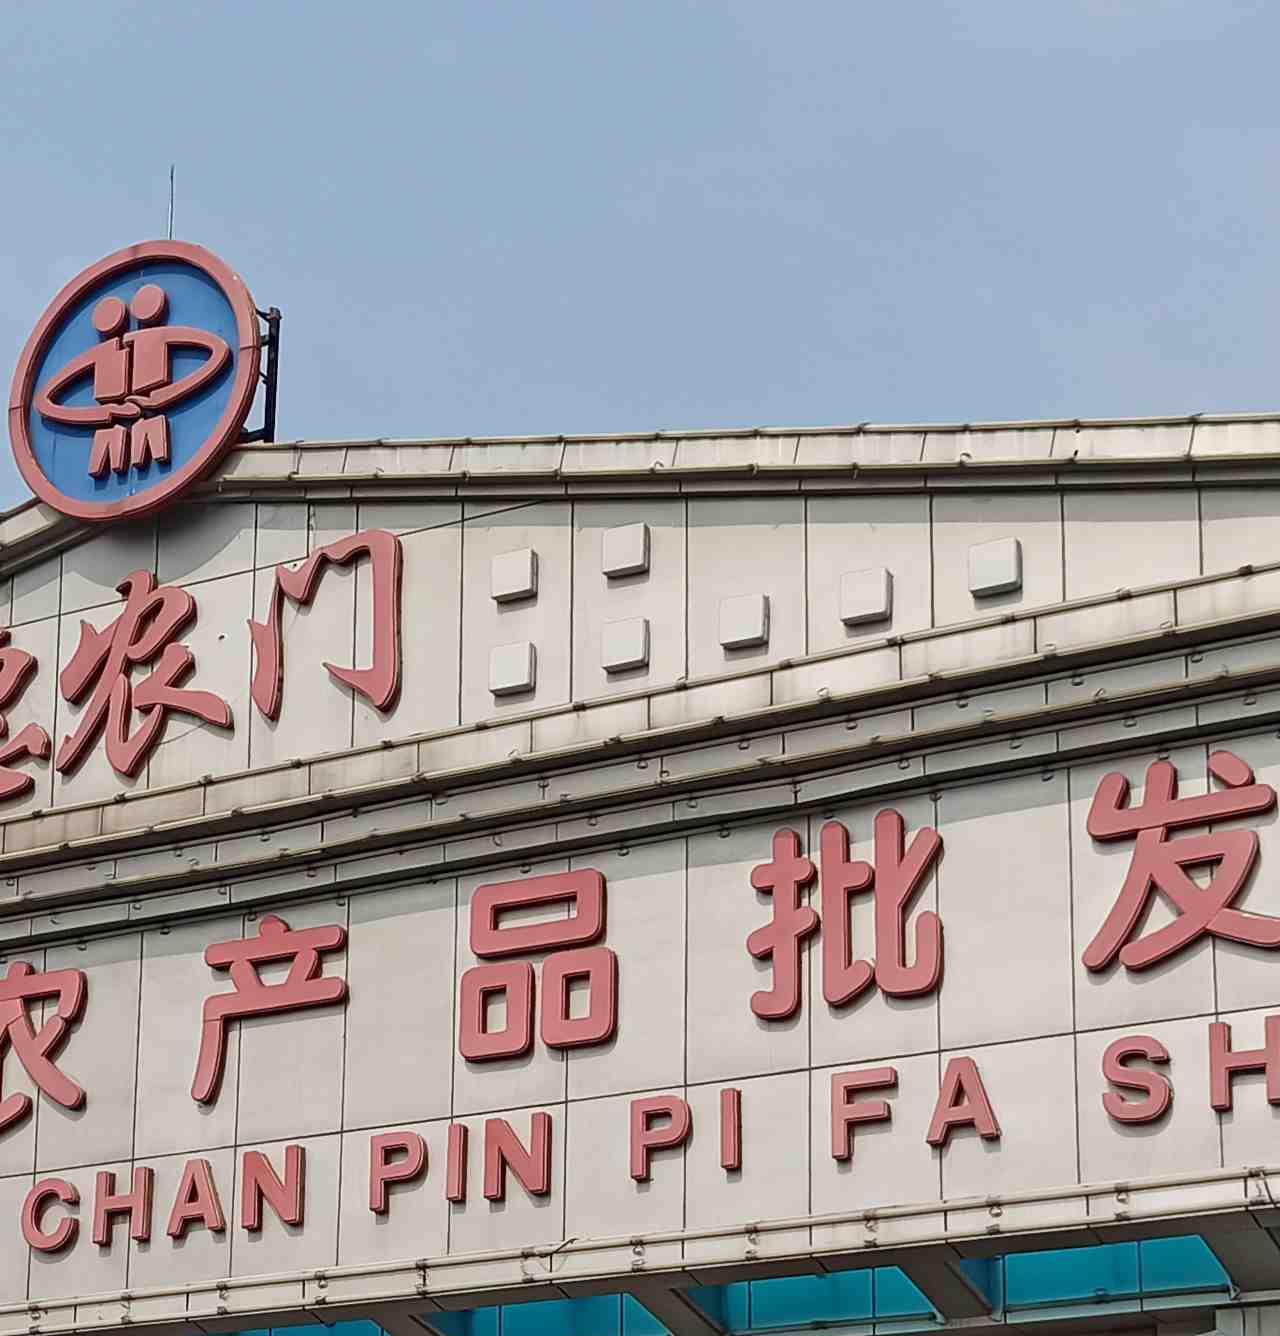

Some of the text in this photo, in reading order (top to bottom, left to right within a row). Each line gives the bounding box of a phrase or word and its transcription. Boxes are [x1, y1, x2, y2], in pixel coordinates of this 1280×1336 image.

[20, 1143, 307, 1254] CHAN
[369, 1111, 553, 1214] PIN
[629, 1088, 743, 1182] PI
[828, 1055, 1001, 1162] FA
